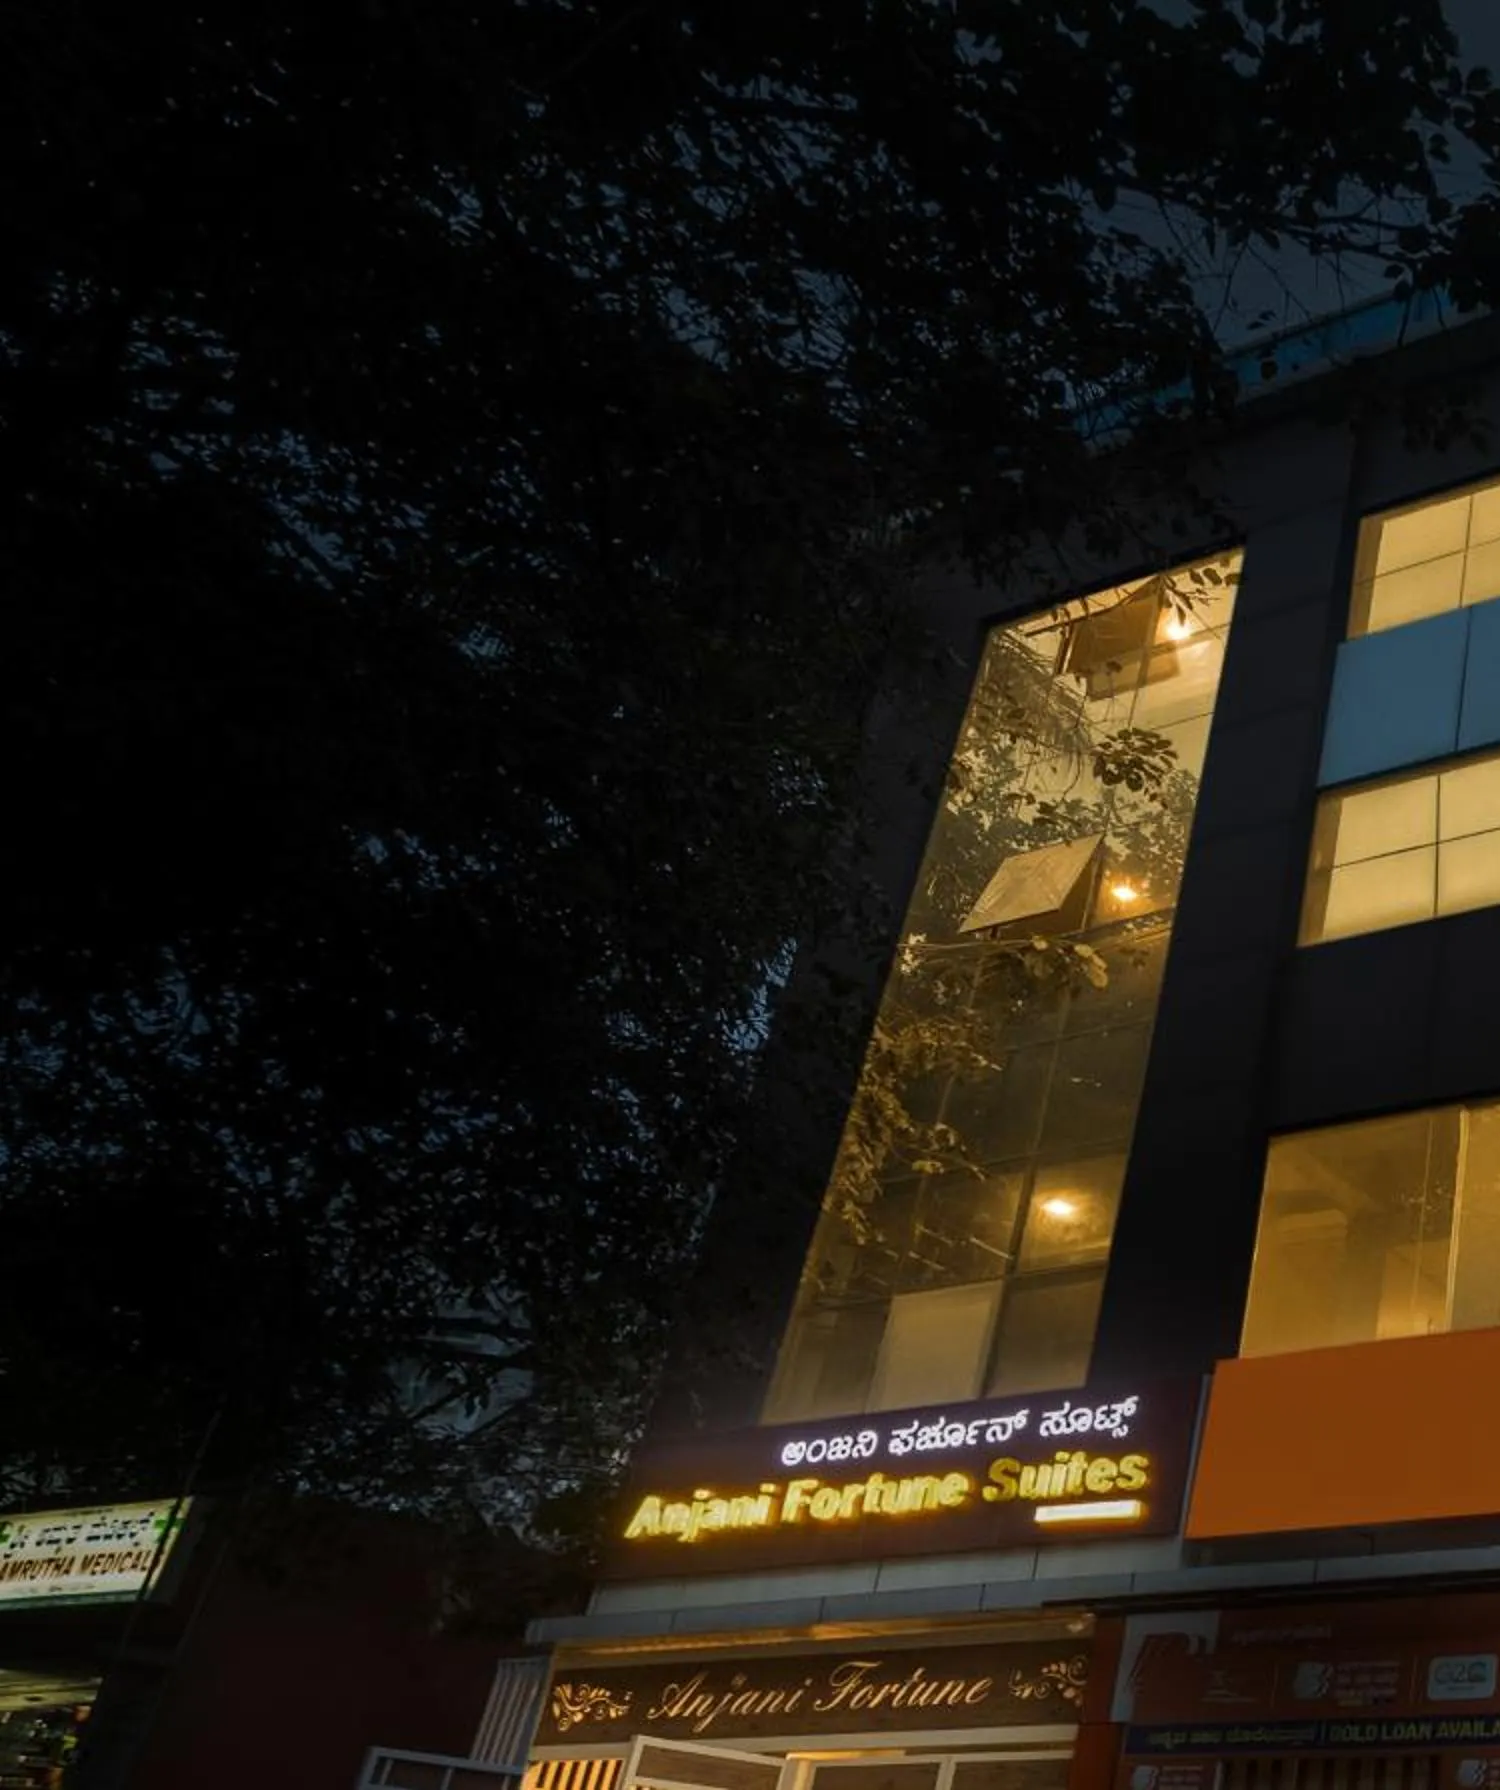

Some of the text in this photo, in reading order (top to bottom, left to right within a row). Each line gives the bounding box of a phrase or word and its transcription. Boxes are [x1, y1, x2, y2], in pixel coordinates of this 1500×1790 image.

[780, 1428, 879, 1467] ಅಂಜನಿ
[624, 1450, 1150, 1543] Anjani Fortune Suites
[647, 1660, 993, 1735] Anjani Fortune
[1380, 1721, 1434, 1742] LOAN
